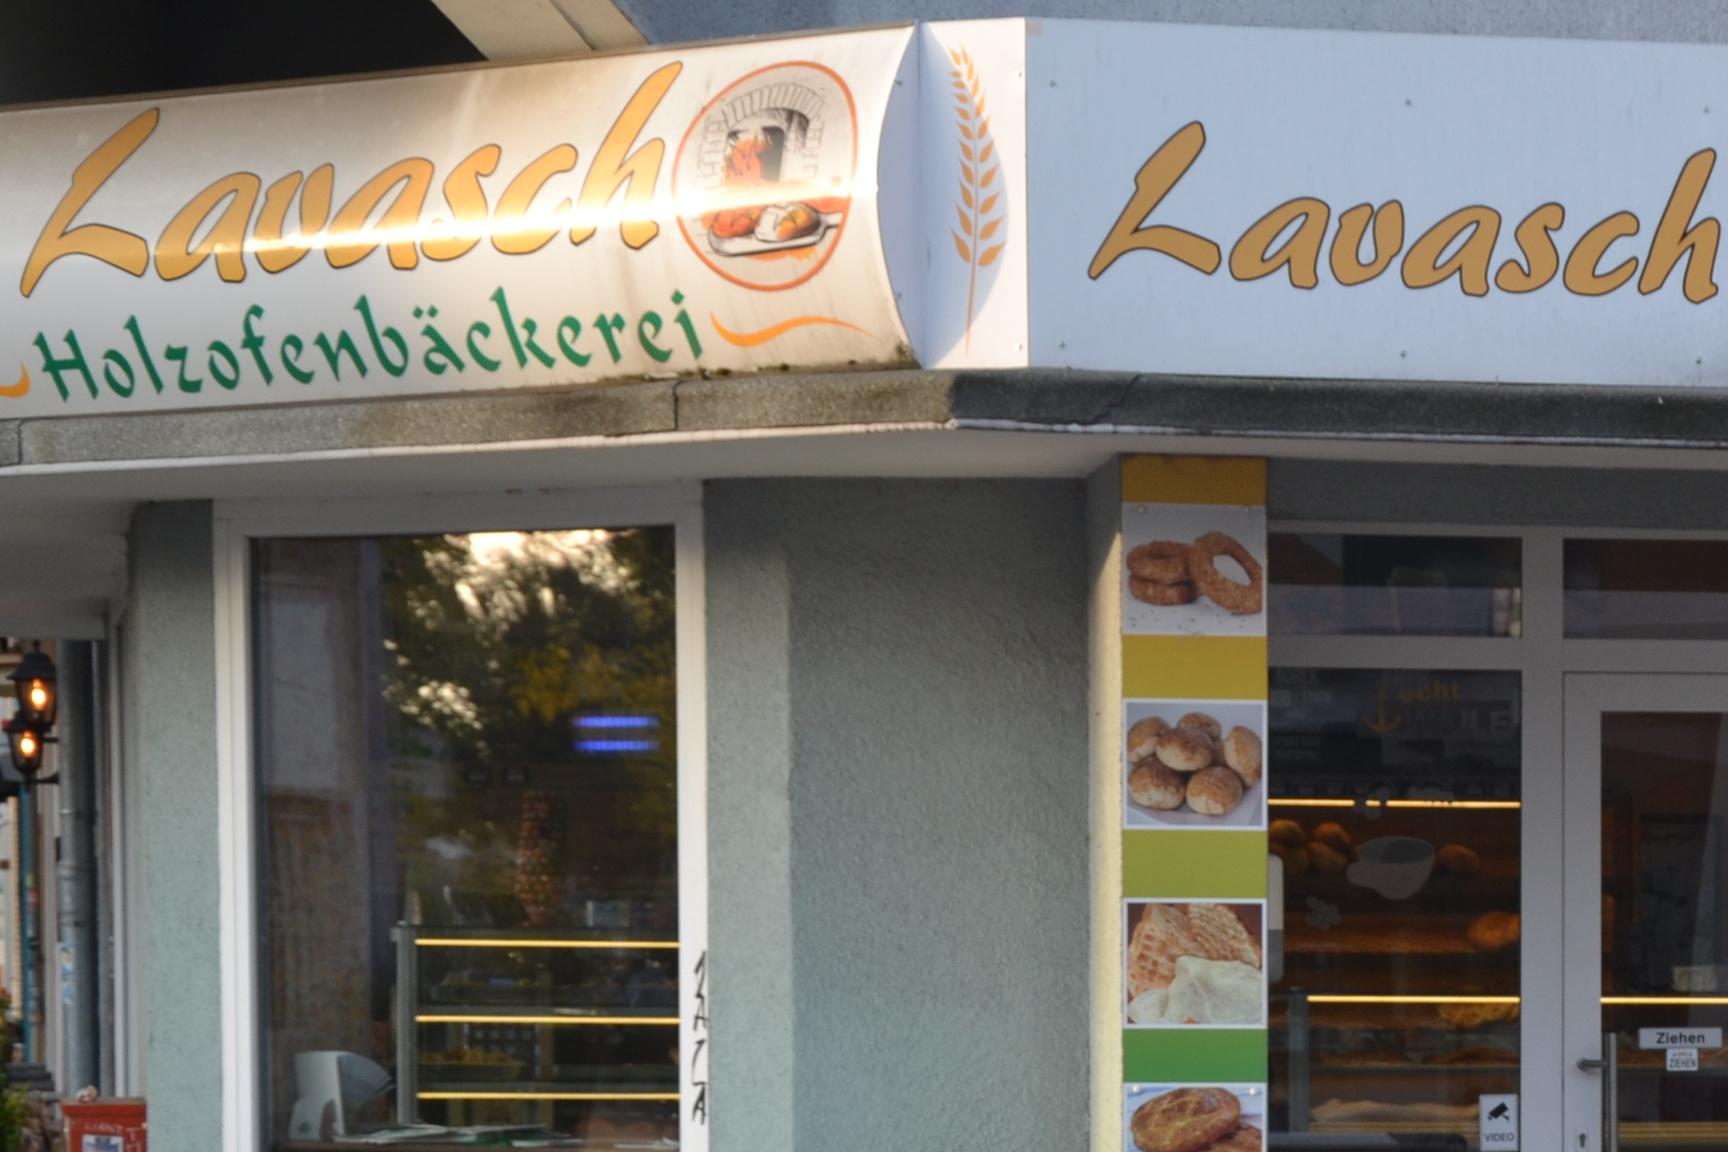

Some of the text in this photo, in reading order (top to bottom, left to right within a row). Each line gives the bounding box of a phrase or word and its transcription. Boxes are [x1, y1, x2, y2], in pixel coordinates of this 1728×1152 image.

[20, 61, 684, 298] Lavasch
[1087, 120, 1720, 304] Lavasch
[33, 290, 704, 402] Holzofenbäckerei
[1656, 1031, 1706, 1044] Ziehen
[1484, 1132, 1514, 1142] VIDEO
